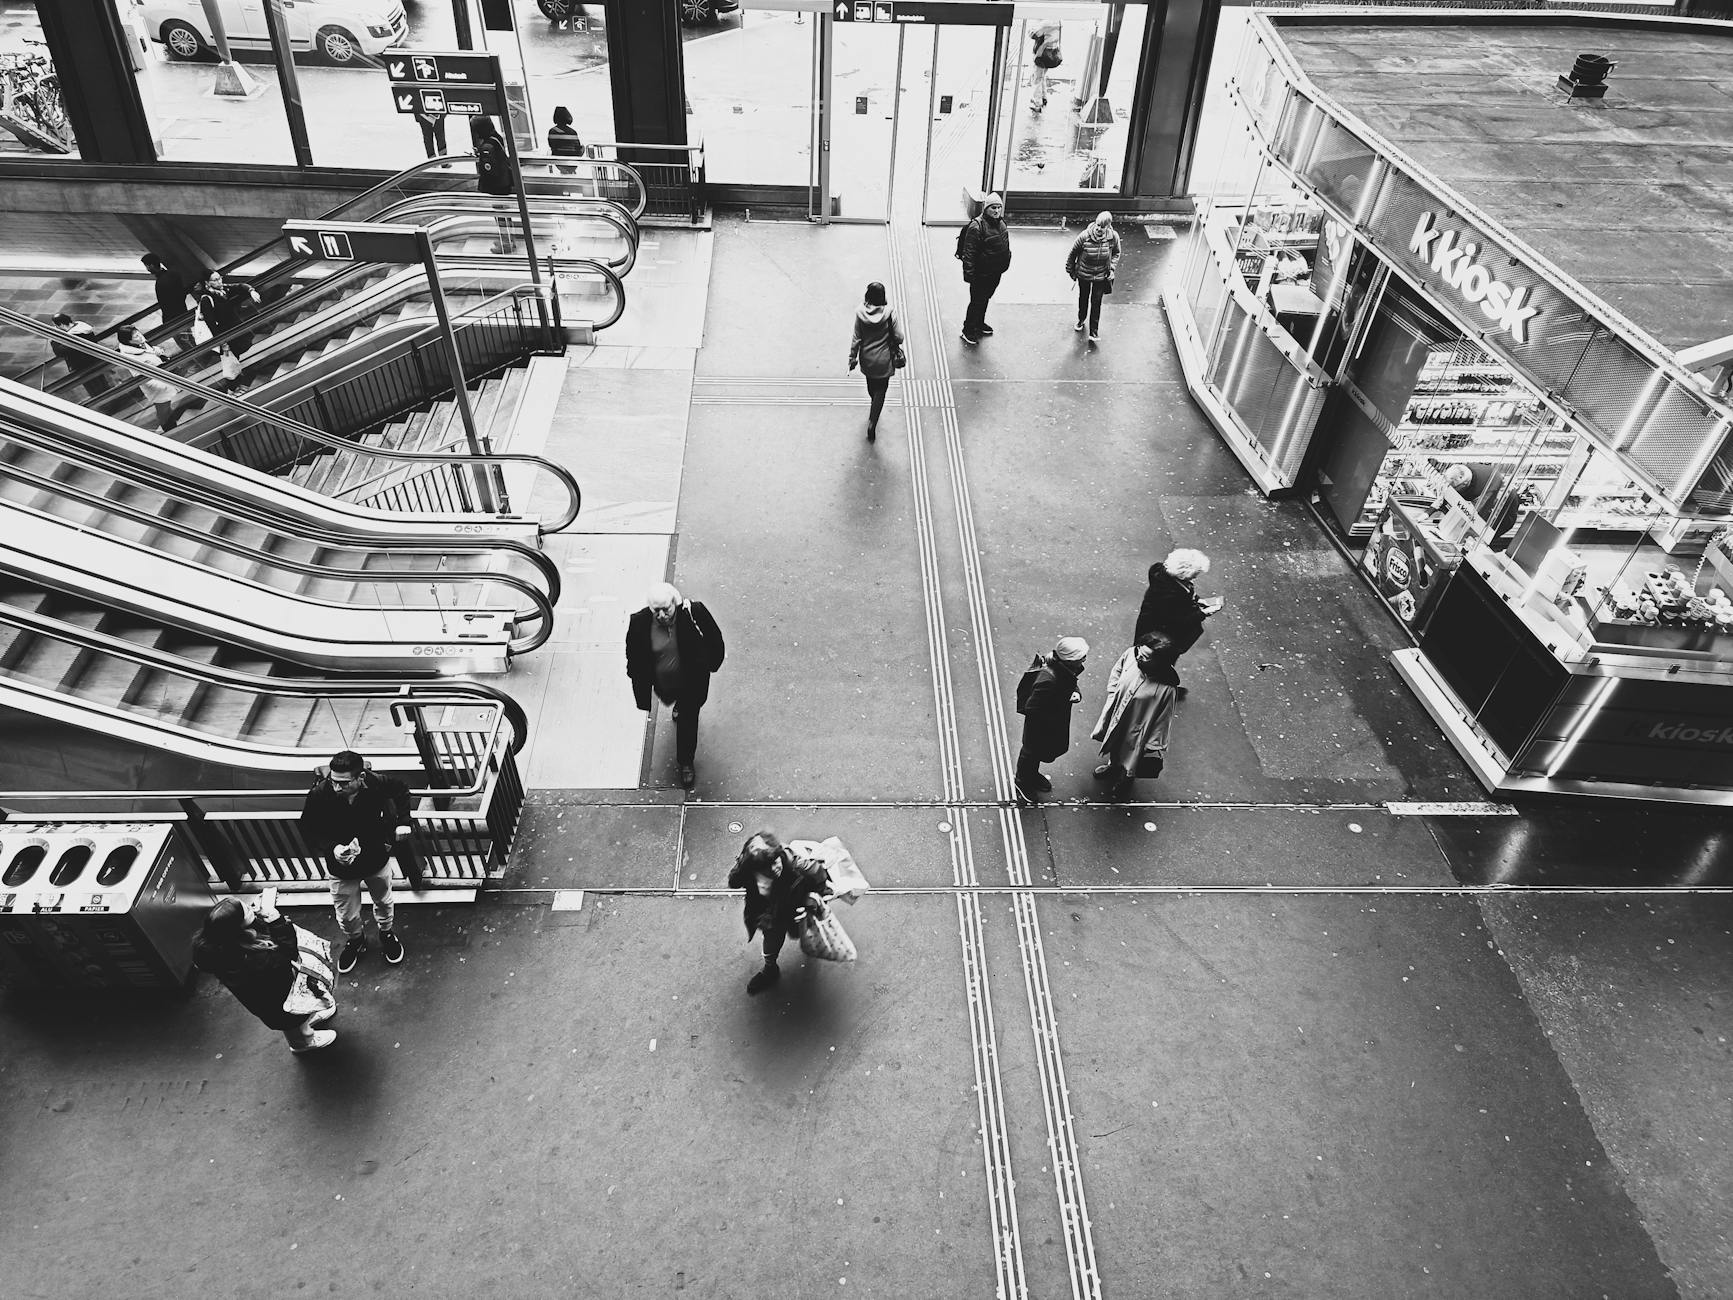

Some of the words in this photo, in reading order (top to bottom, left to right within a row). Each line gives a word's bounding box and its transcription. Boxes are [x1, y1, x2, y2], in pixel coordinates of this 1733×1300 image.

[1408, 211, 1439, 263] k
[1430, 230, 1538, 342] kiosk
[1390, 557, 1407, 577] Frisco
[1648, 722, 1733, 744] kiosk
